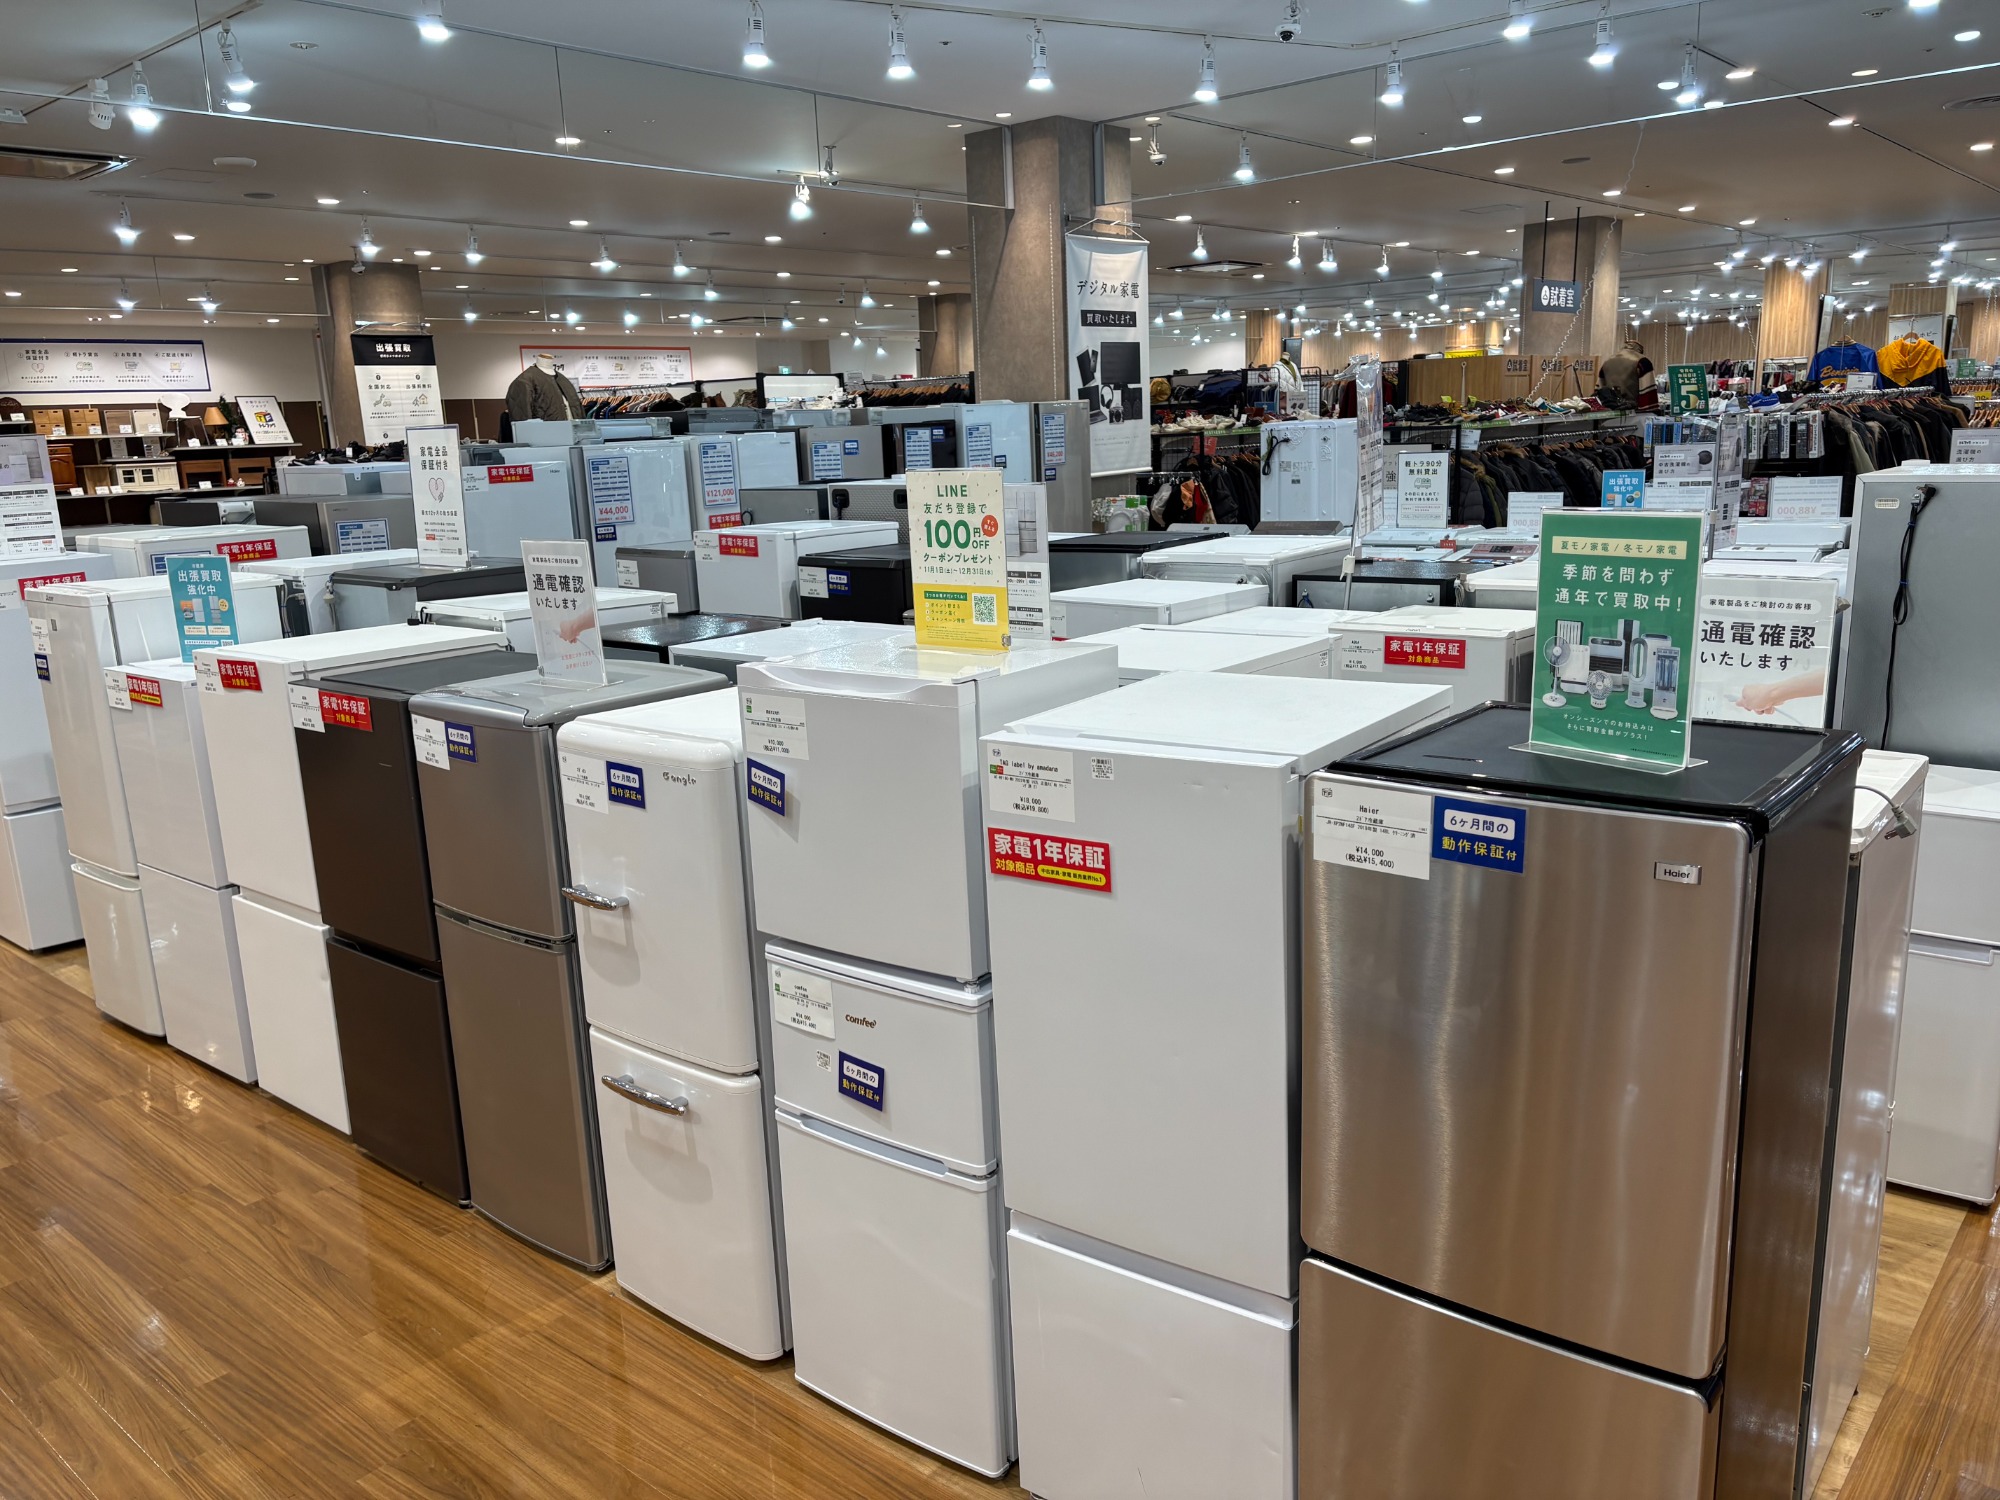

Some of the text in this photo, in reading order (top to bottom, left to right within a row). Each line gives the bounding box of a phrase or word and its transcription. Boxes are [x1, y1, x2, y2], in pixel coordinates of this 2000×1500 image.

[1076, 279, 1140, 299] デジタル家電
[1086, 312, 1134, 325] 買取いたします。
[375, 343, 411, 353] 出張買取
[420, 445, 448, 457] 家電全品
[421, 460, 448, 470] 保証付き
[1409, 468, 1438, 476] 無料貸出
[937, 485, 968, 498] LINE
[923, 502, 988, 515] 友だち登録で
[923, 519, 971, 550] 100
[972, 540, 990, 550] OFF
[1561, 541, 1610, 552] 夏モノ家電
[1623, 543, 1678, 555] 冬モノ家電
[923, 552, 993, 565] クーポンプレゼント
[178, 569, 223, 582] 出張買取
[1563, 564, 1675, 586] 季節を問わず
[187, 584, 216, 596] 強化中
[532, 573, 586, 594] 通電確認
[535, 597, 578, 611] いたします
[1555, 588, 1682, 612] 通年で買取中!
[1709, 598, 1812, 611] 家電製品をご検討のお客様
[1700, 620, 1816, 650] 通電確認
[1389, 640, 1460, 656] 家電1年保証
[1408, 655, 1440, 664] 対象商品
[1700, 651, 1793, 671] いたします
[220, 663, 256, 678] 家電1年保証
[321, 696, 366, 716] 家電1年保証
[1359, 804, 1380, 815] Haier
[1450, 815, 1509, 834] 6ヶ月間の
[994, 833, 1106, 870] 家電1年保証
[1355, 846, 1385, 857] ¥14,000
[1441, 836, 1517, 862] 動作保証付
[995, 858, 1036, 876] 対象商品
[1345, 853, 1395, 869] (税込¥15,400)
[1664, 868, 1691, 879] Haier
[845, 1013, 877, 1029] comfee
[846, 1065, 876, 1083] 6ヶ月間の
[842, 1078, 880, 1102] 動作保証付
